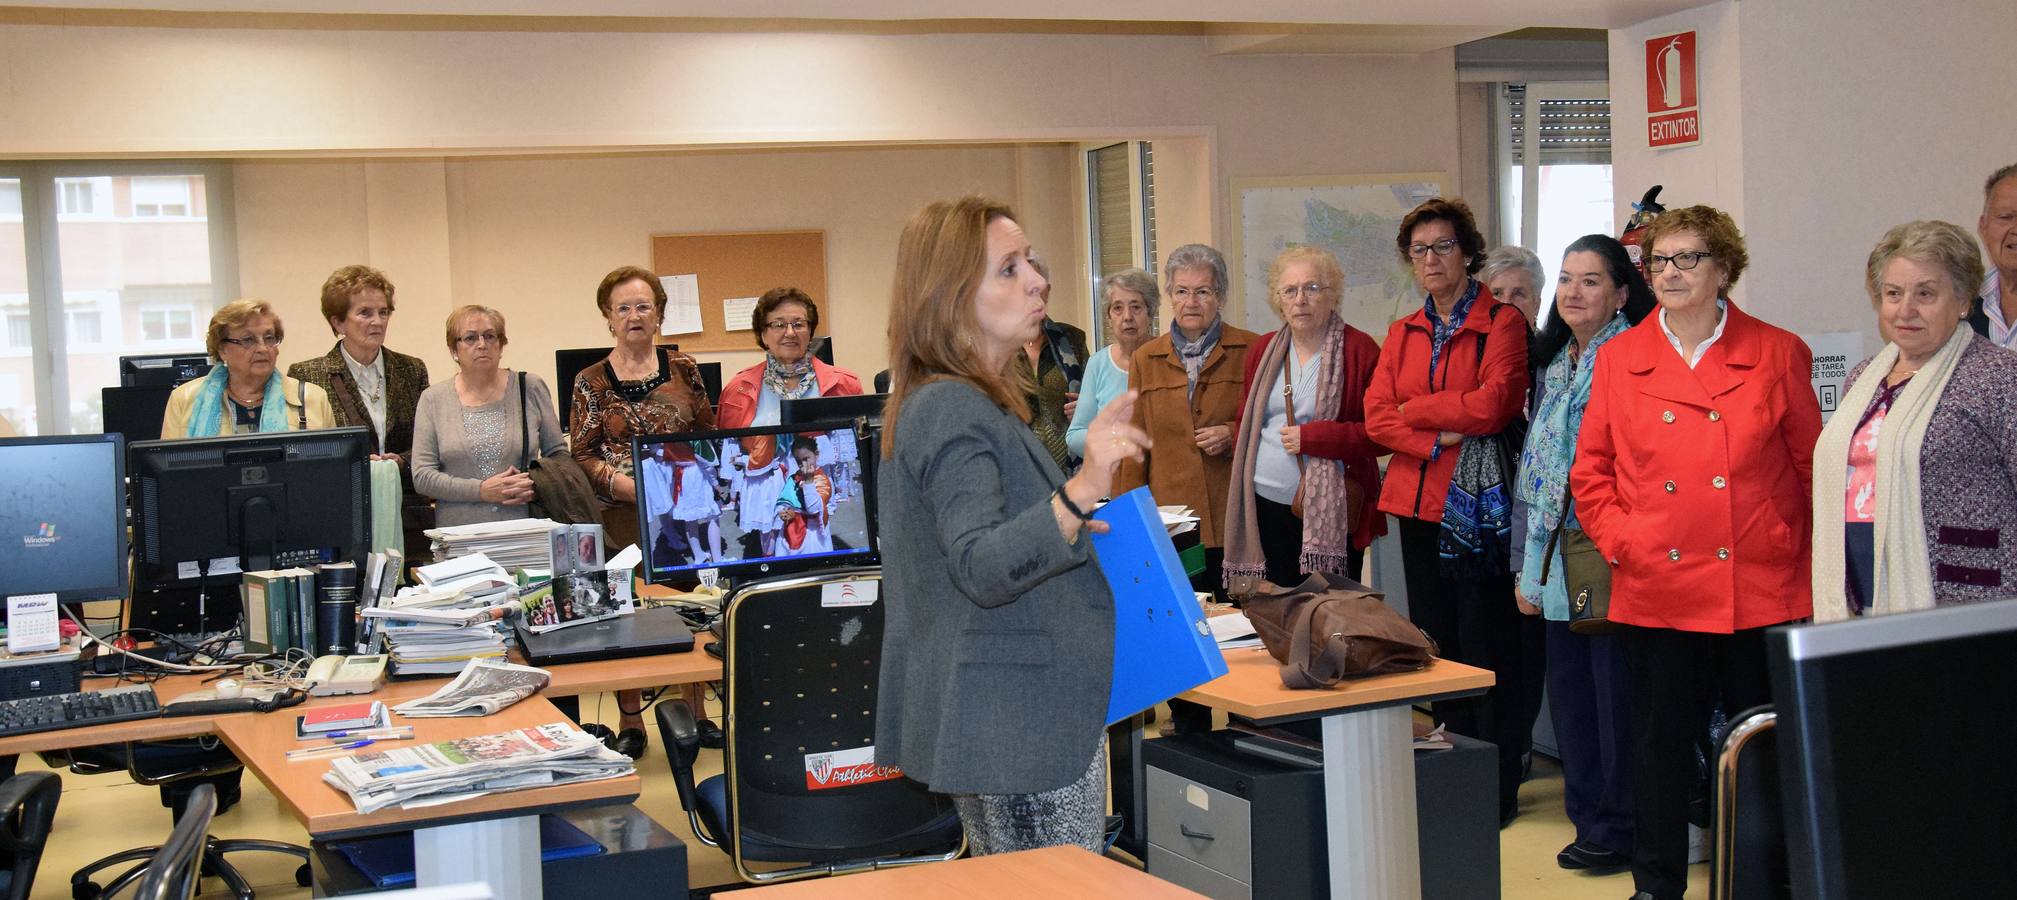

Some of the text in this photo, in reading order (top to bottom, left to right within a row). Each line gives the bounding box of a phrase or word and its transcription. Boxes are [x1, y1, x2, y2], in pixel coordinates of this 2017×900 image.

[1651, 117, 1697, 140] EXTINTOR
[1821, 370, 1846, 378] TODOS
[24, 535, 55, 544] Windows
[832, 764, 874, 783] Athletic
